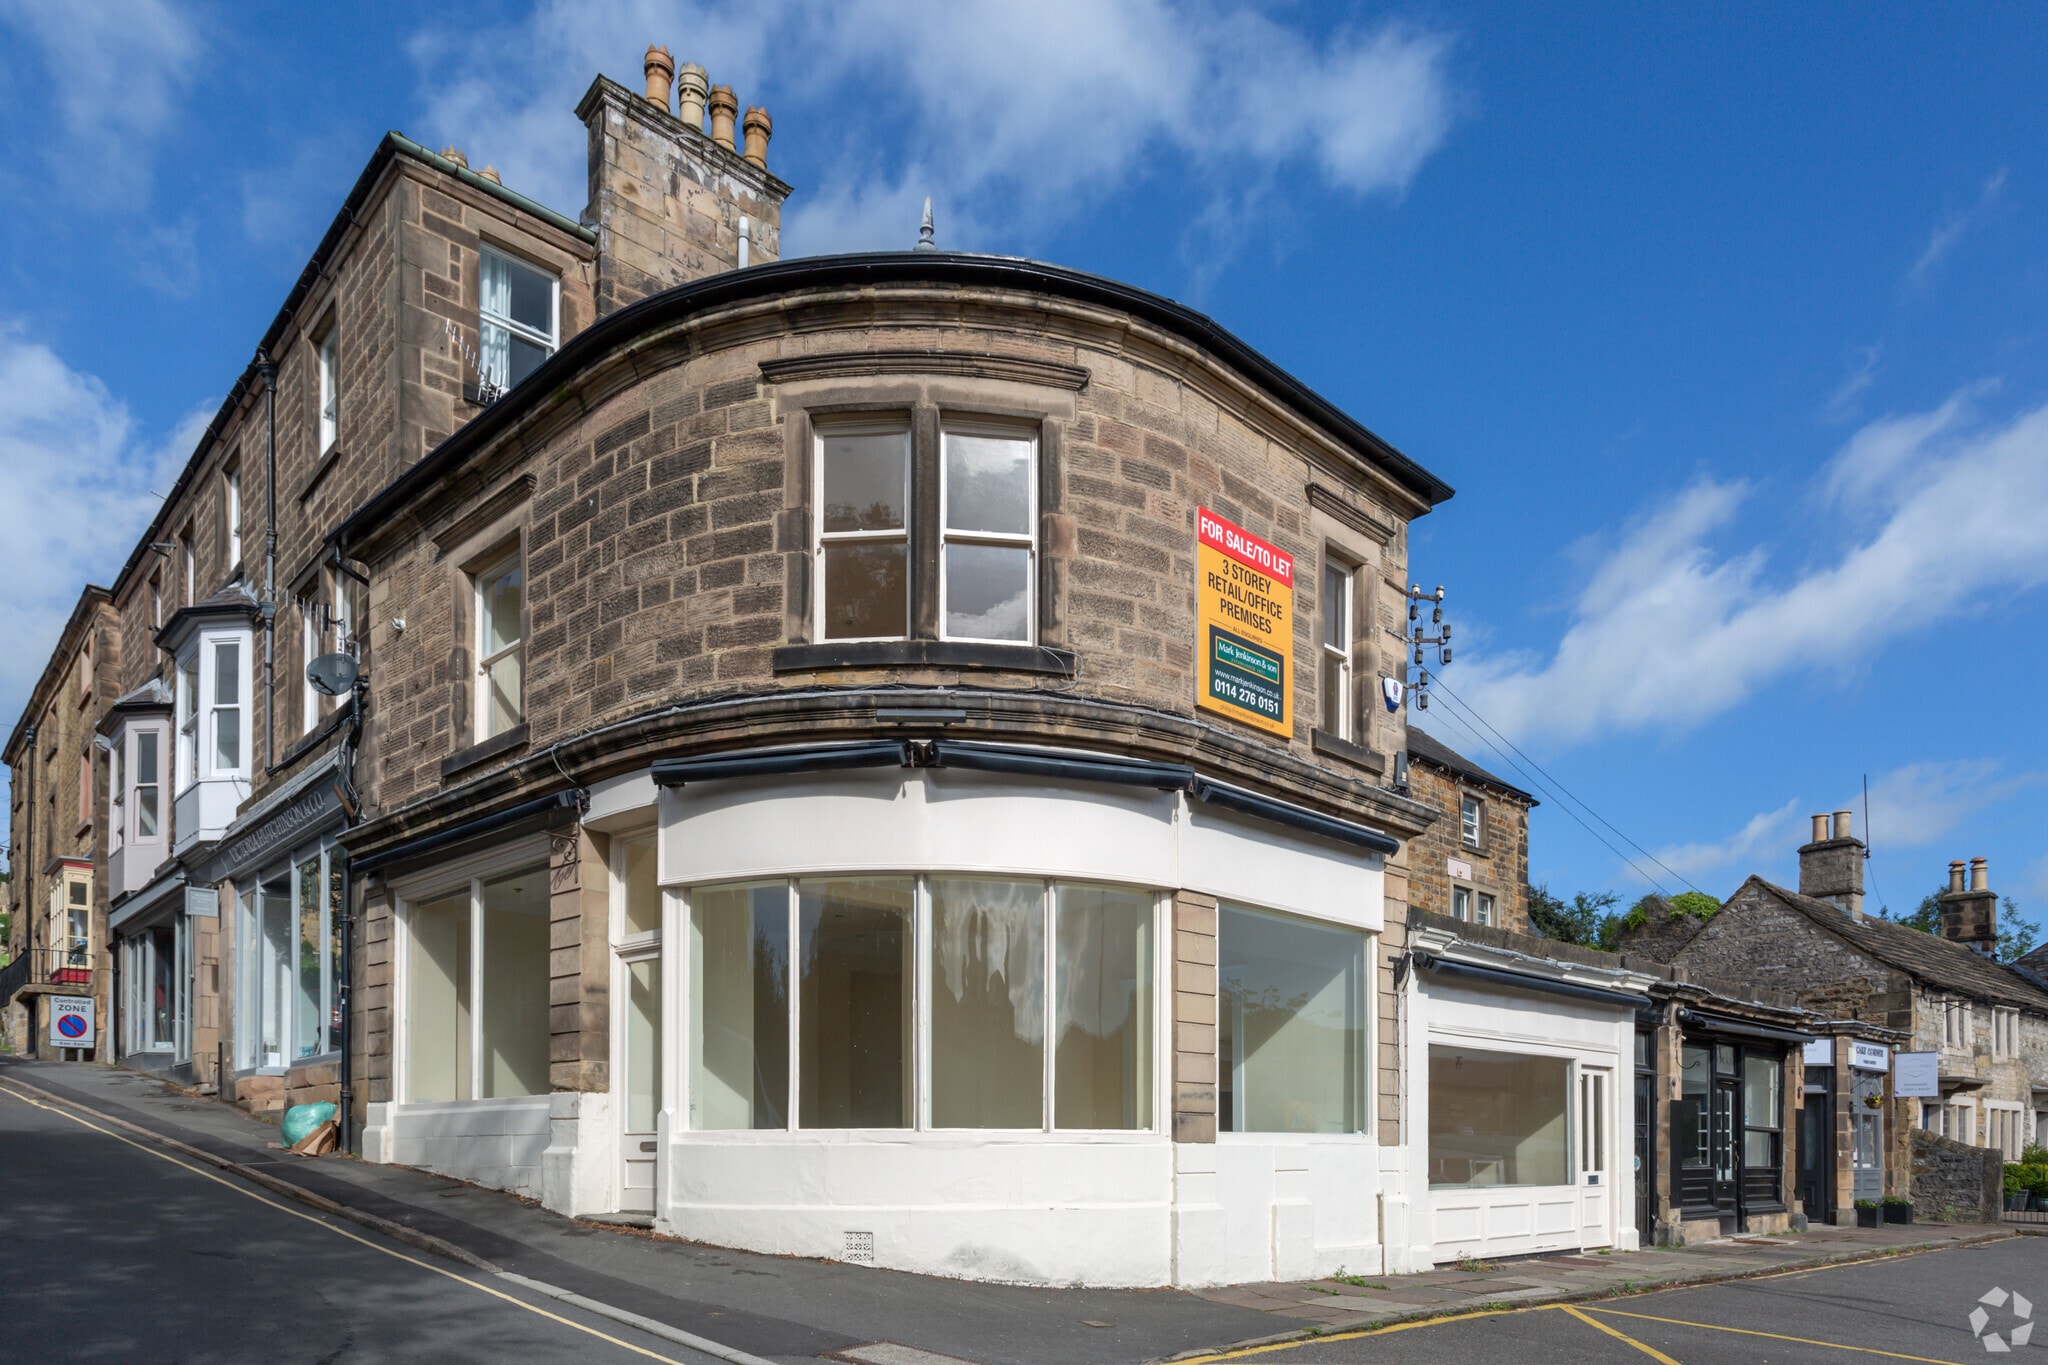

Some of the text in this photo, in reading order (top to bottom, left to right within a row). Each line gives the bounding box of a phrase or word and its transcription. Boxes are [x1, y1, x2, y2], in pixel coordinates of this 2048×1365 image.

[1201, 516, 1291, 578] FOR SALE/TO LET
[1222, 559, 1271, 595] 3 STOREY
[1208, 571, 1282, 620] RETAIL/OFFICE
[1220, 597, 1272, 635] PREMISES
[1218, 642, 1235, 656] Mark
[1261, 659, 1267, 670] &
[1267, 663, 1278, 674] son
[1214, 679, 1279, 715] 0114 276 0151
[54, 997, 91, 1005] Controlled
[58, 1004, 87, 1012] ZONE
